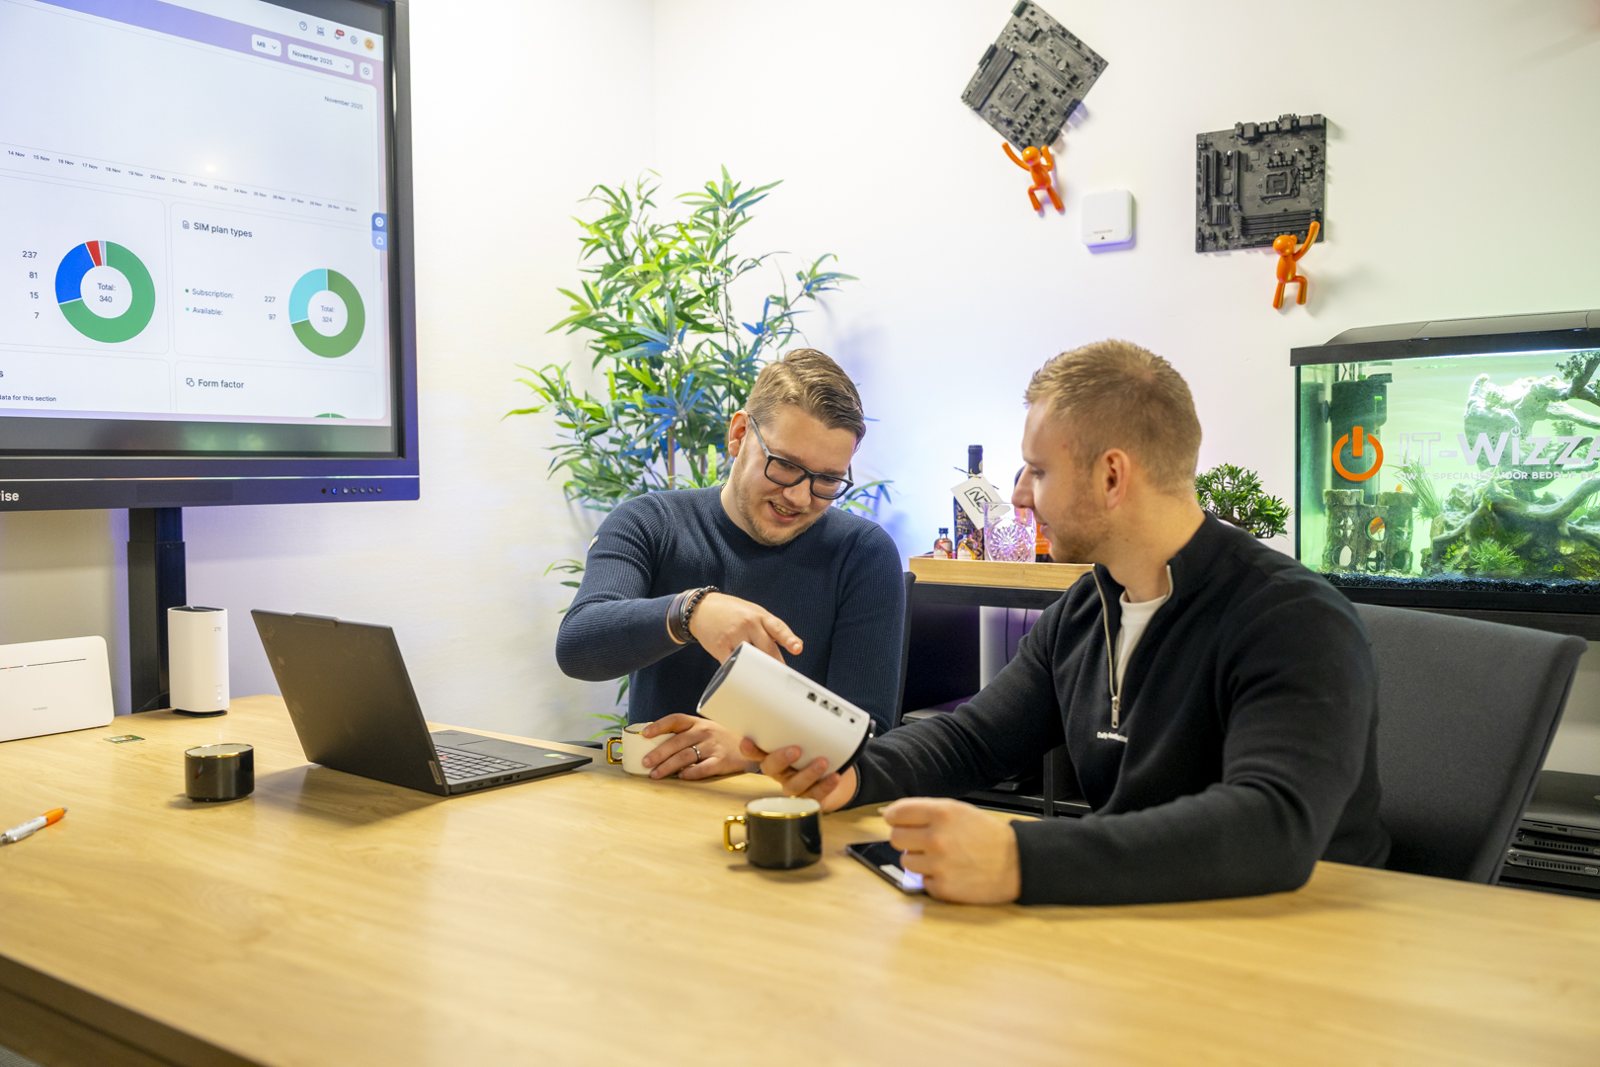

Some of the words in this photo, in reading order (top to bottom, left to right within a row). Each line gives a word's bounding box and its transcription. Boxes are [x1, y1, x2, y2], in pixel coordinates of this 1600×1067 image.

[292, 50, 319, 61] November
[320, 56, 333, 65] 2025
[324, 95, 349, 106] November
[193, 222, 209, 232] SIM
[211, 226, 229, 235] plan
[230, 228, 253, 238] types
[22, 250, 38, 259] 237
[29, 271, 38, 279] 81
[97, 282, 116, 291] Total:
[30, 291, 39, 299] 15
[99, 295, 113, 303] 340
[264, 295, 276, 303] 227
[34, 311, 39, 319] 7
[198, 378, 219, 387] Form
[220, 379, 244, 389] factor
[0, 489, 20, 501] ise
